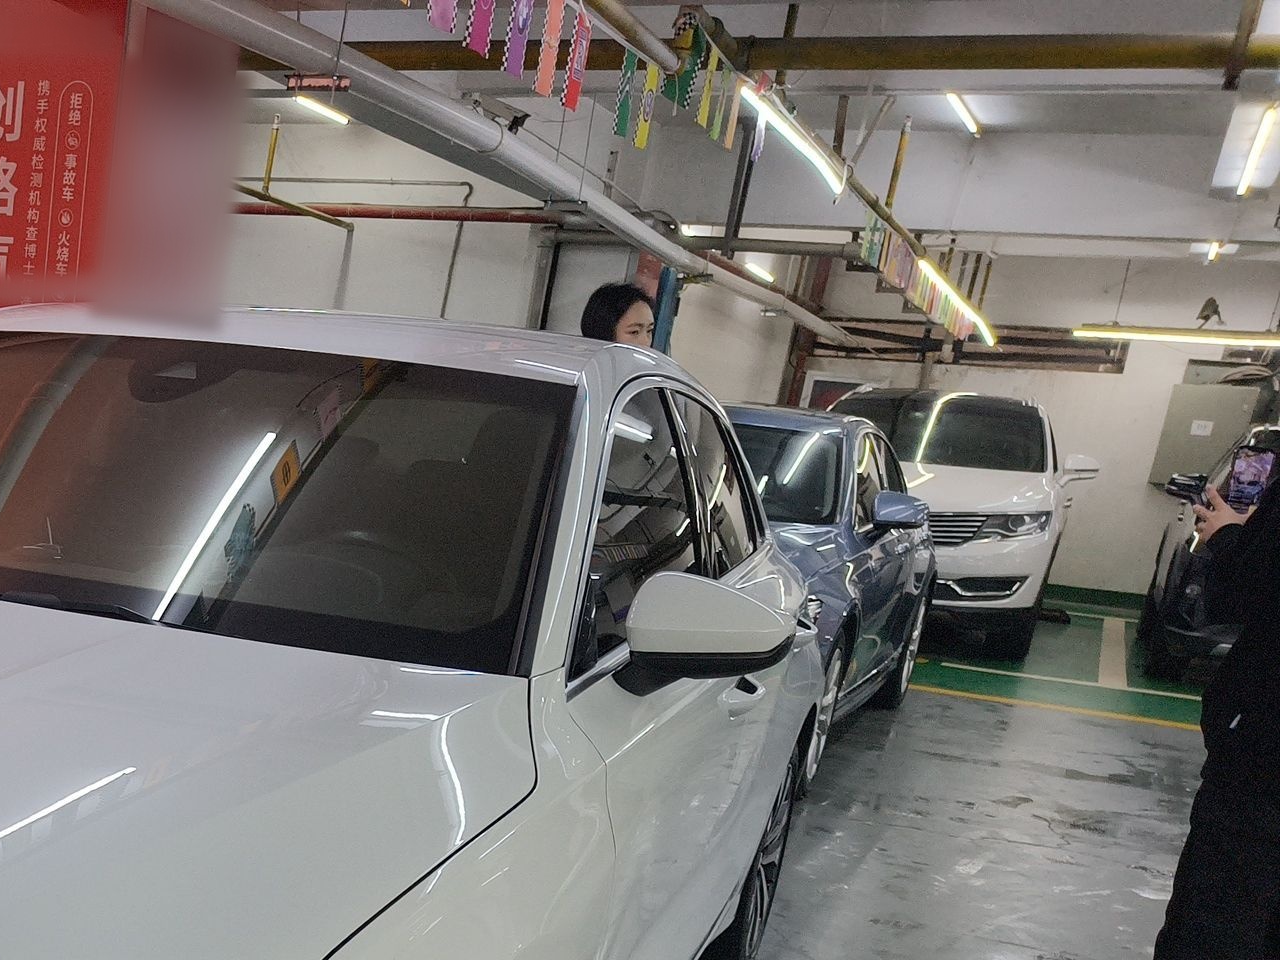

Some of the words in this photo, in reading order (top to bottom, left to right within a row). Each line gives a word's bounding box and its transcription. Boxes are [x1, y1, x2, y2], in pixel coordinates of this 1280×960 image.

[68, 93, 83, 126] 拒绝
[62, 154, 78, 201] 事故车
[55, 231, 70, 277] 火烧车
